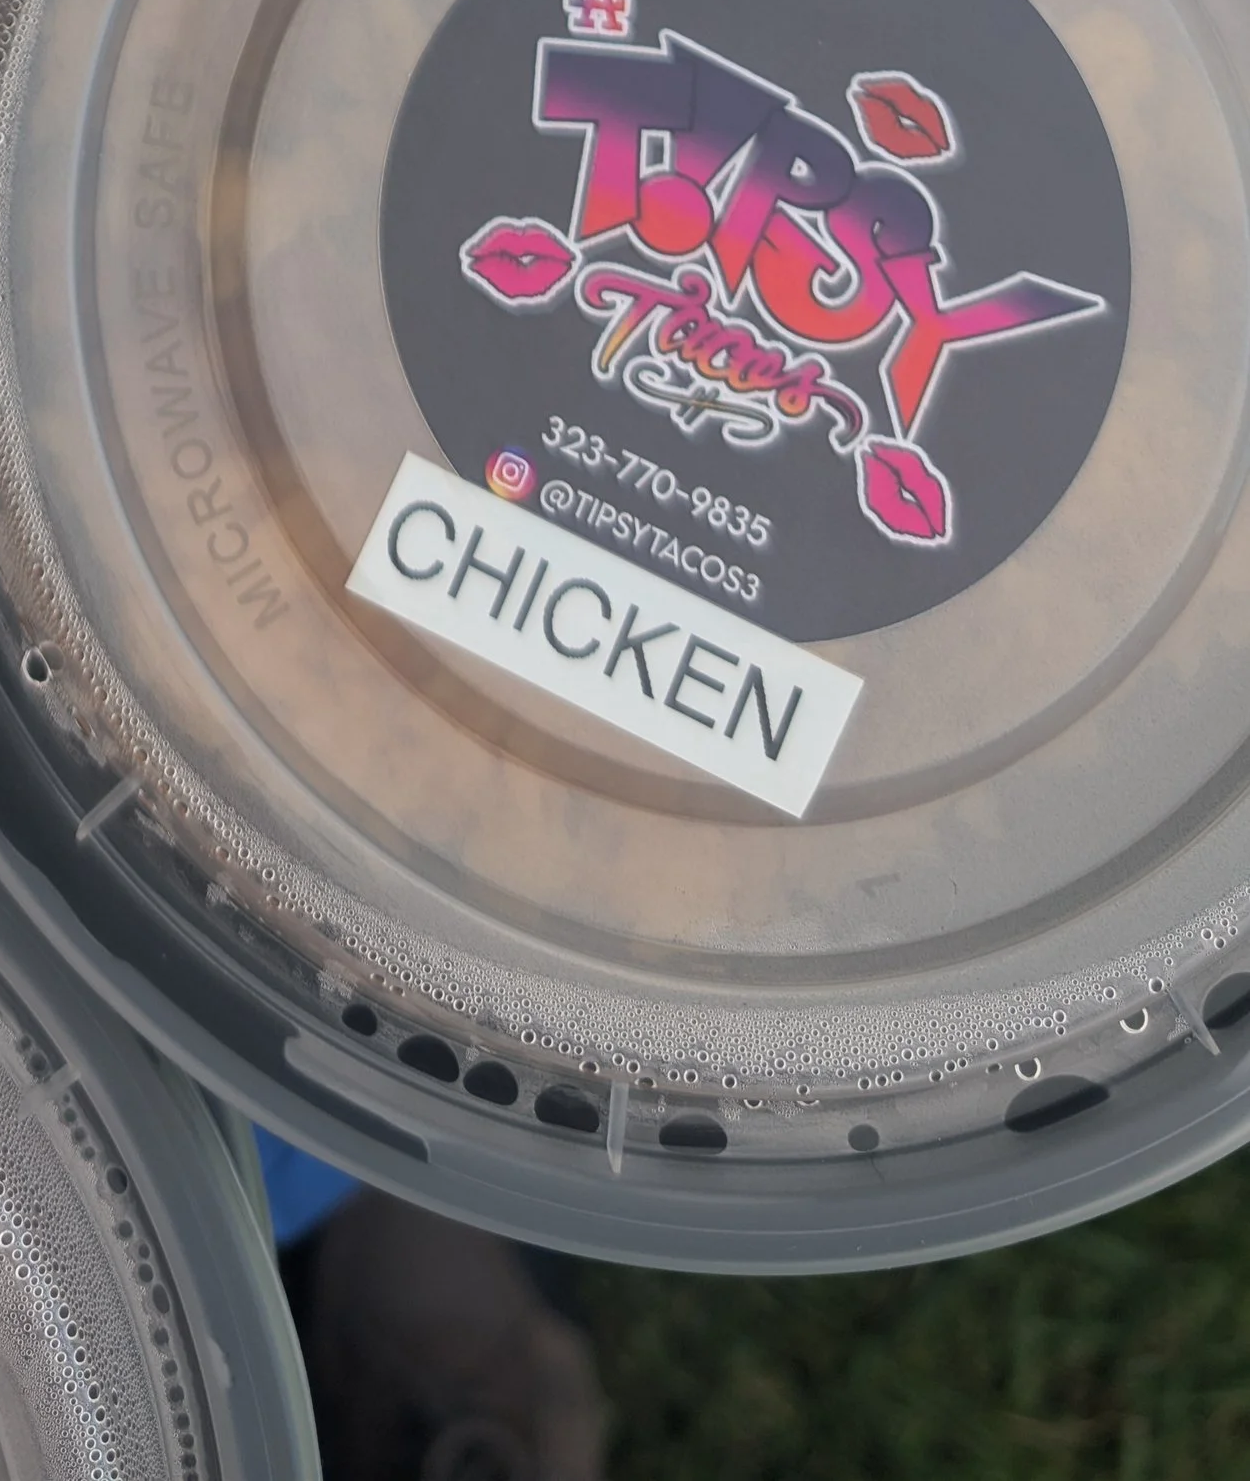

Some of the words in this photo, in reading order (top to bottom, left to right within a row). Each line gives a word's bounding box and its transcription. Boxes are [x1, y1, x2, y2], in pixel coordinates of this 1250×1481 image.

[134, 75, 193, 231] SAFE
[533, 31, 1106, 441] TIPSY
[131, 268, 290, 632] MICROWAVE
[575, 262, 866, 452] Tacos
[539, 478, 761, 602] @TIPSYTACOS3
[541, 416, 773, 548] 323-770-9835
[386, 500, 804, 761] CHICKEN
